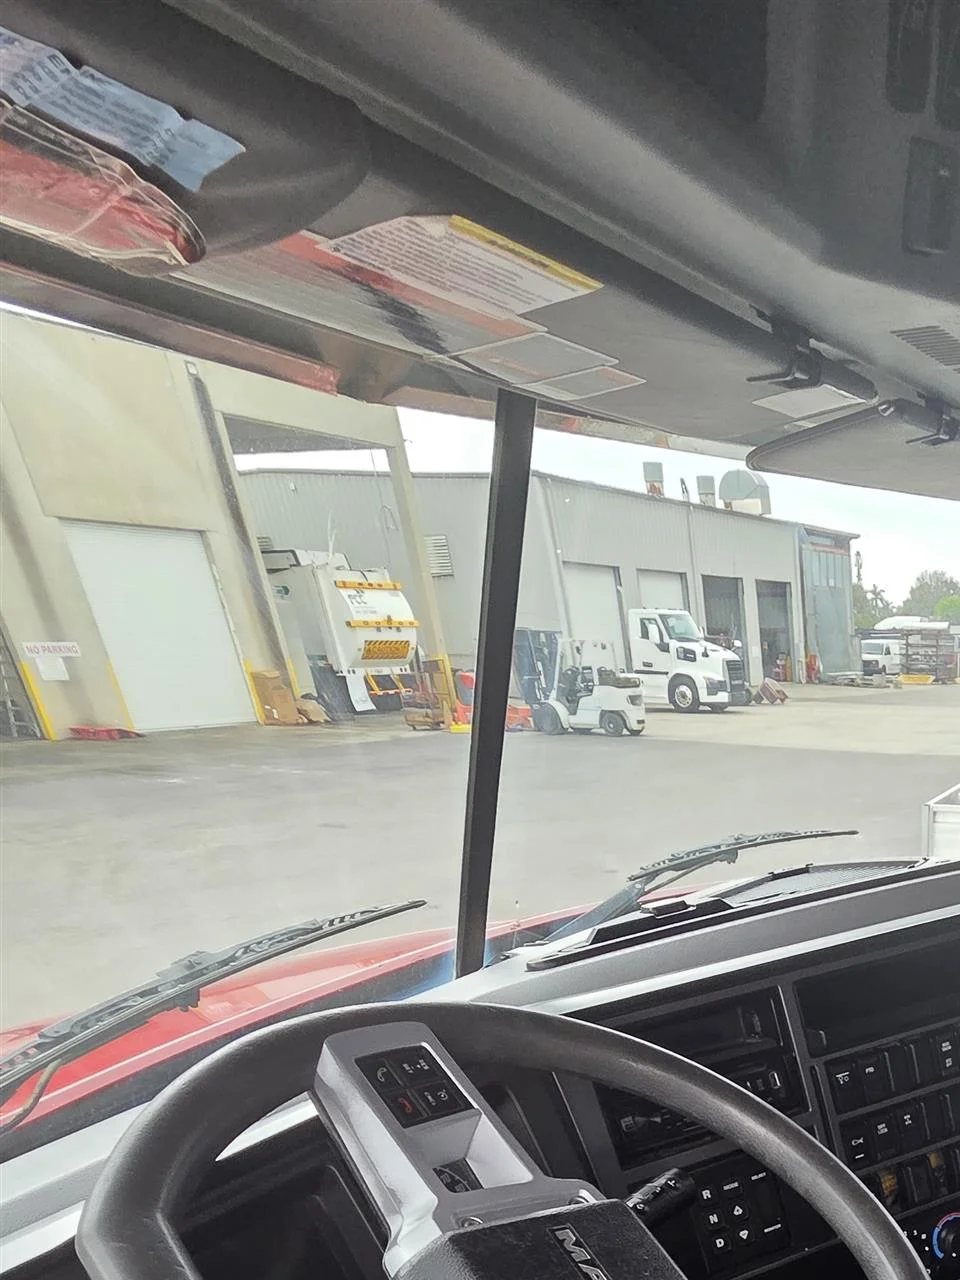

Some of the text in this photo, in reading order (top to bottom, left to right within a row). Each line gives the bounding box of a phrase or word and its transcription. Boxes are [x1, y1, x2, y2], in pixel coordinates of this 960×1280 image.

[25, 645, 80, 655] NO PARKING
[701, 1189, 712, 1200] R
[708, 1213, 719, 1224] N
[715, 1238, 725, 1248] D
